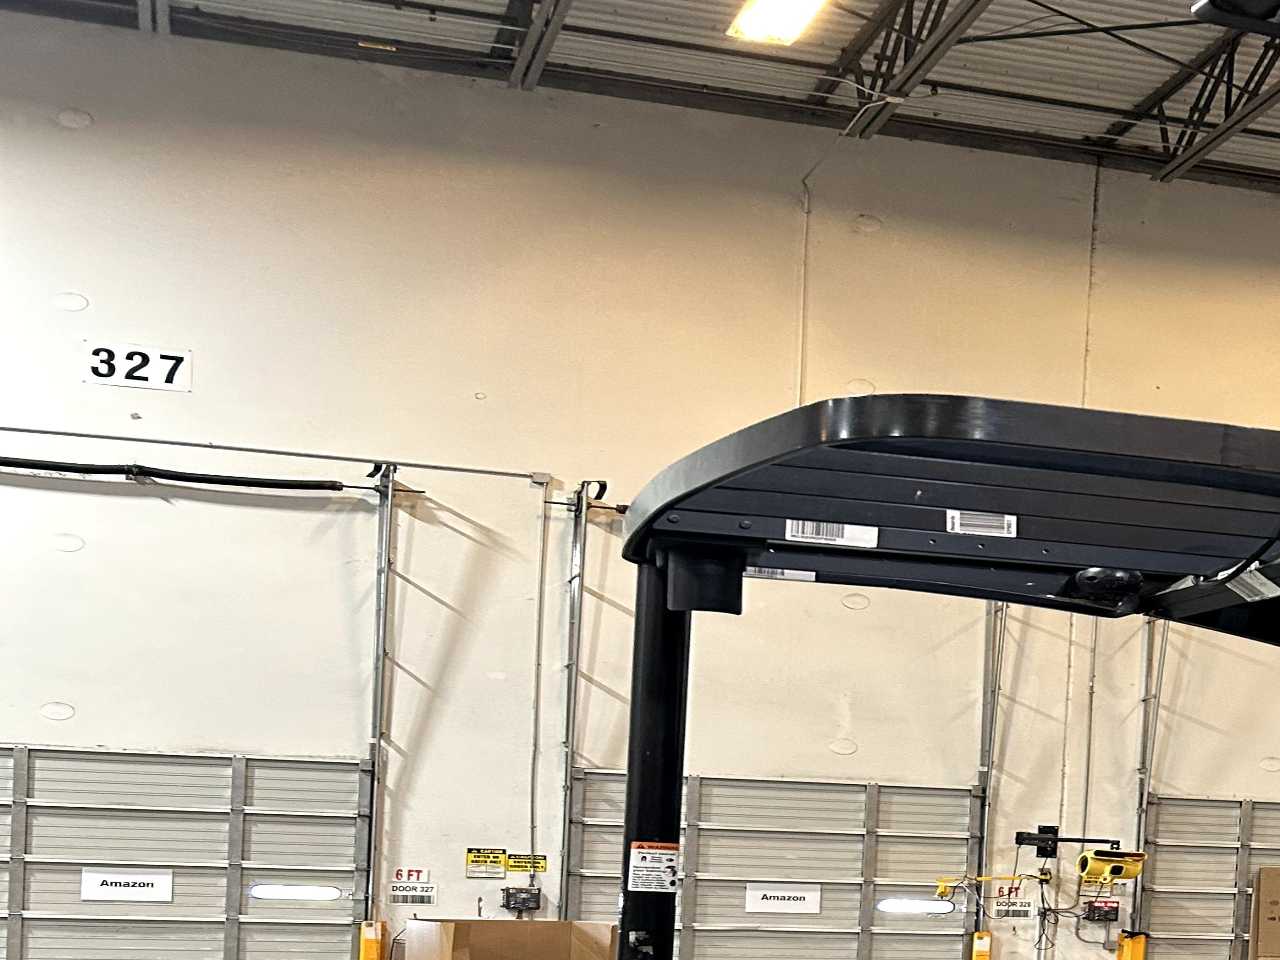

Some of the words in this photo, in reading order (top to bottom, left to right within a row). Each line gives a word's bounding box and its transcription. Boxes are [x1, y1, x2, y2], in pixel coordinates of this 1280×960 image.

[90, 347, 185, 385] 327
[395, 869, 403, 880] 6
[407, 869, 422, 881] FT
[99, 879, 155, 888] Amazon
[391, 885, 418, 893] DOOR
[998, 886, 1004, 897] 6
[761, 893, 806, 902] Amazon
